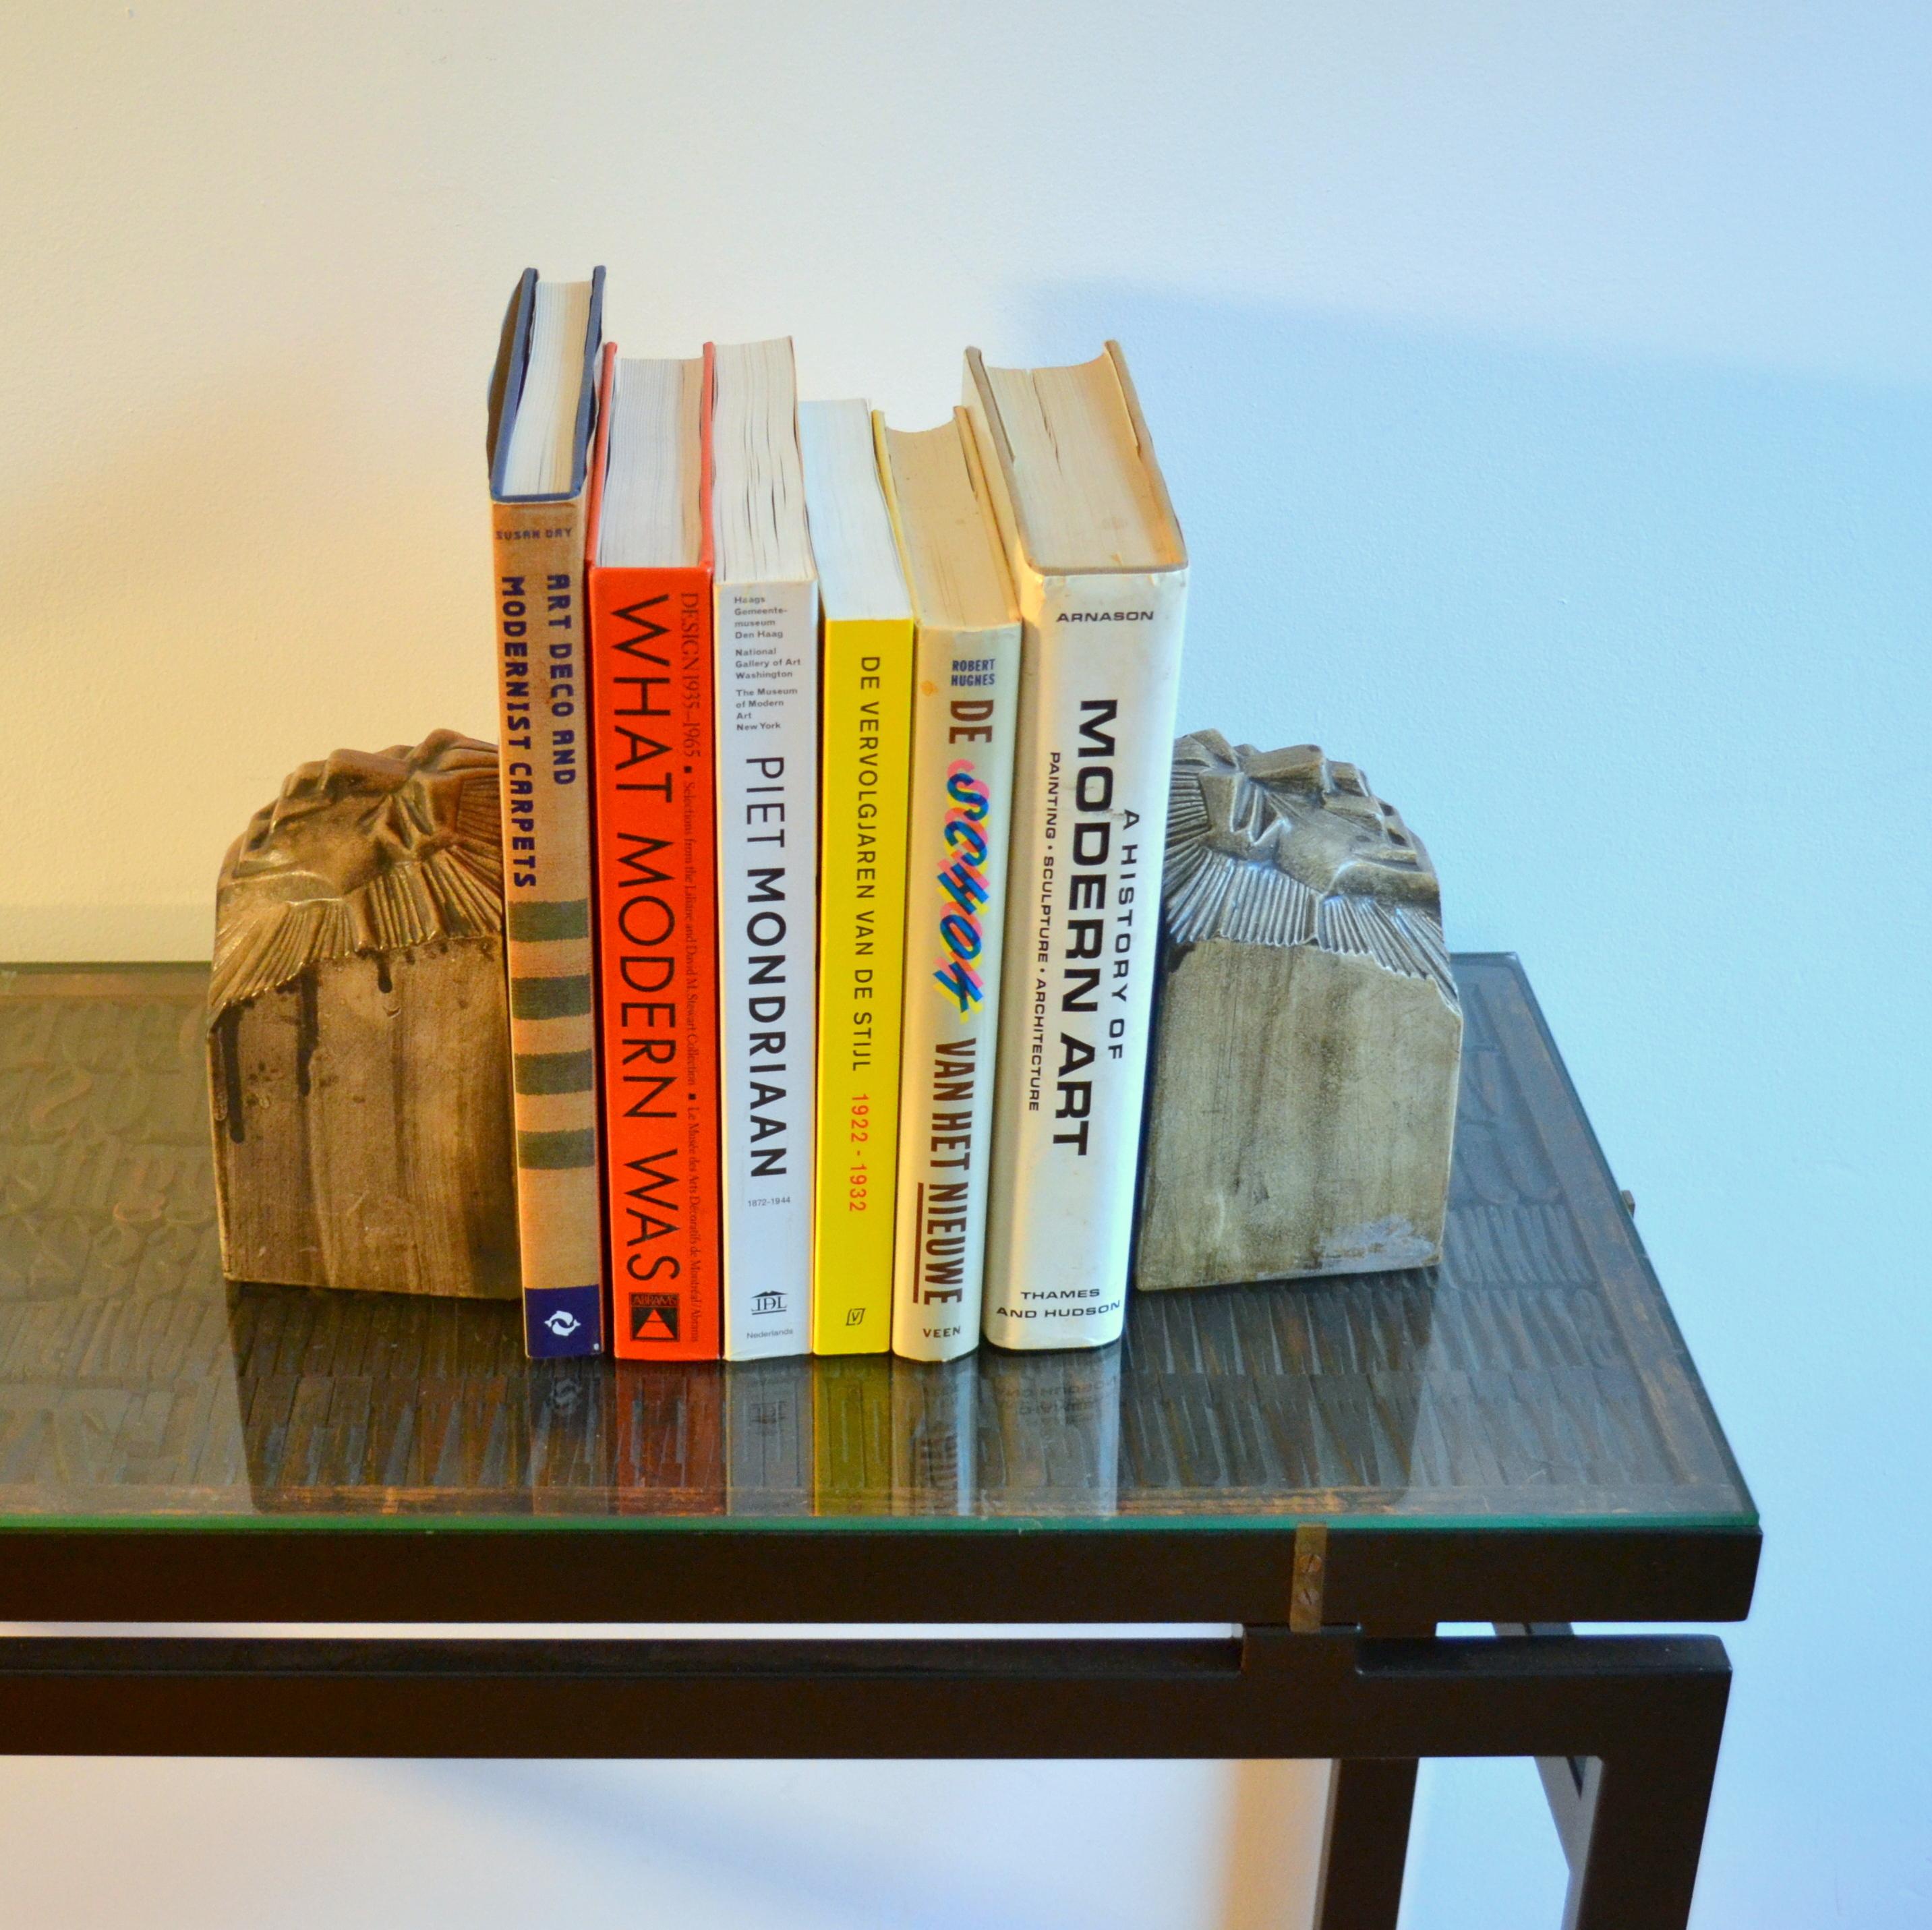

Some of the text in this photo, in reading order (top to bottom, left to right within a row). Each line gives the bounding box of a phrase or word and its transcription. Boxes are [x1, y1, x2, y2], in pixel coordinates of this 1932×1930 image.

[496, 527, 572, 540] SUSAN DAY
[734, 596, 765, 605] Haags
[734, 607, 788, 616] Gemeente-
[1056, 610, 1154, 622] ARNASON
[681, 593, 700, 670] DESIGN
[735, 630, 784, 639] Den Haag
[736, 648, 777, 656] National
[736, 658, 801, 668] Gallery of Art
[952, 658, 996, 672] ROBERT
[547, 574, 576, 785] ART DECO AND
[736, 670, 793, 680] Washington
[860, 656, 880, 691] DE
[951, 673, 995, 687] HUGHES
[736, 699, 784, 709] of Modern
[502, 577, 536, 887] MODERNIST CARPETS
[760, 722, 781, 730] York
[682, 782, 697, 835] Selections
[856, 701, 879, 899] VERVOLGJAREN
[684, 838, 697, 863] from
[684, 867, 697, 883] the
[610, 593, 681, 1281] WHAT MODERN WAS
[685, 924, 697, 942] and
[855, 913, 875, 956] VAN
[1028, 751, 1061, 1112] PAINTING SCULPTURE ARCHITECTURE
[1053, 699, 1118, 1156] MODERN ART
[1108, 810, 1140, 1059] A HISTORY OF
[685, 945, 698, 975] David
[746, 757, 787, 1177] PIET MONDRIAAN
[854, 969, 873, 1000] DE
[686, 993, 699, 1030] Stewart
[924, 699, 994, 1306] DE SCHOK VAN HET NIEUWE
[853, 1012, 873, 1071] STIJL
[686, 1033, 700, 1085] Collection
[687, 1107, 700, 1120] Le
[850, 1094, 869, 1142] 1922
[689, 1157, 701, 1173] des
[689, 1175, 701, 1194] Arts
[849, 1163, 867, 1212] 1932
[690, 1246, 702, 1258] de
[1020, 1288, 1101, 1300] THAMES
[996, 1299, 1121, 1318] AND HUDSON
[747, 1328, 794, 1340] Nederlands
[923, 1326, 962, 1338] VEEN
